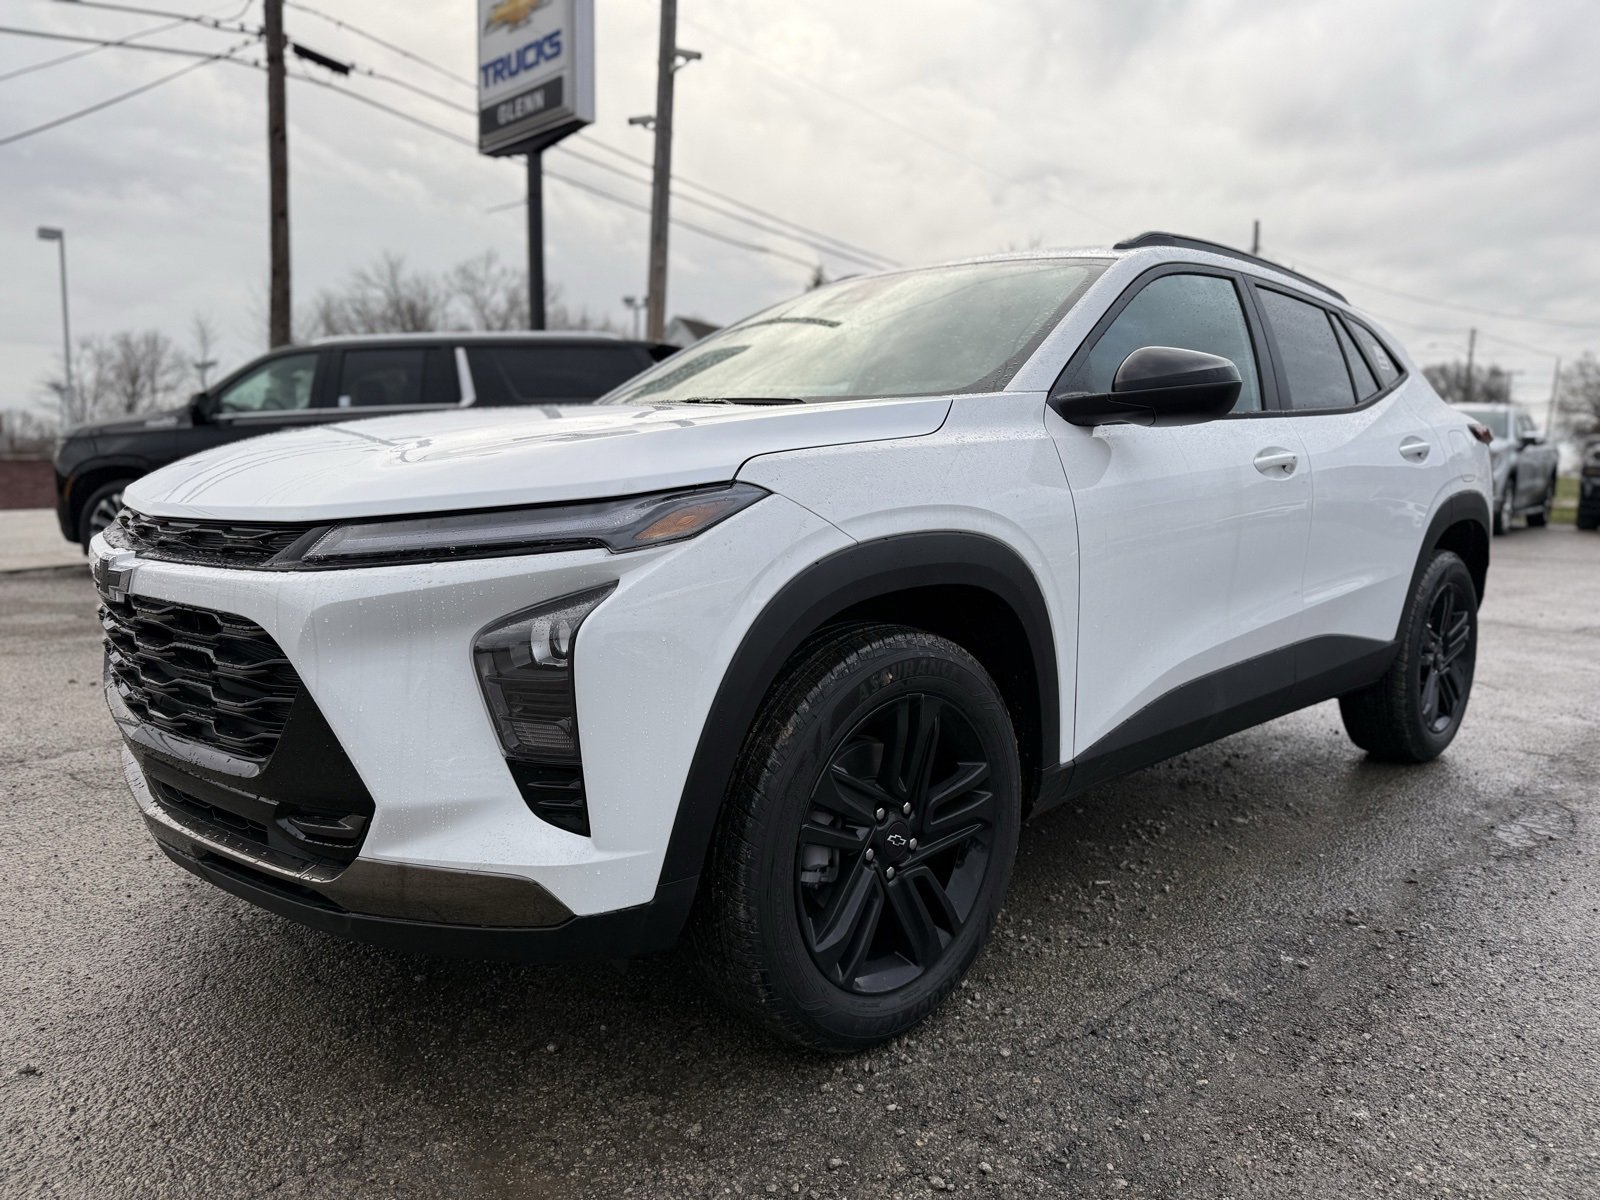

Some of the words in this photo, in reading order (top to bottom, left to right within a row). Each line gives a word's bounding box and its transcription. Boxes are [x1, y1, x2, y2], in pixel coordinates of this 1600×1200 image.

[481, 29, 562, 88] TRUCKS
[497, 88, 545, 125] GLENN
[857, 658, 960, 702] ASURANC
